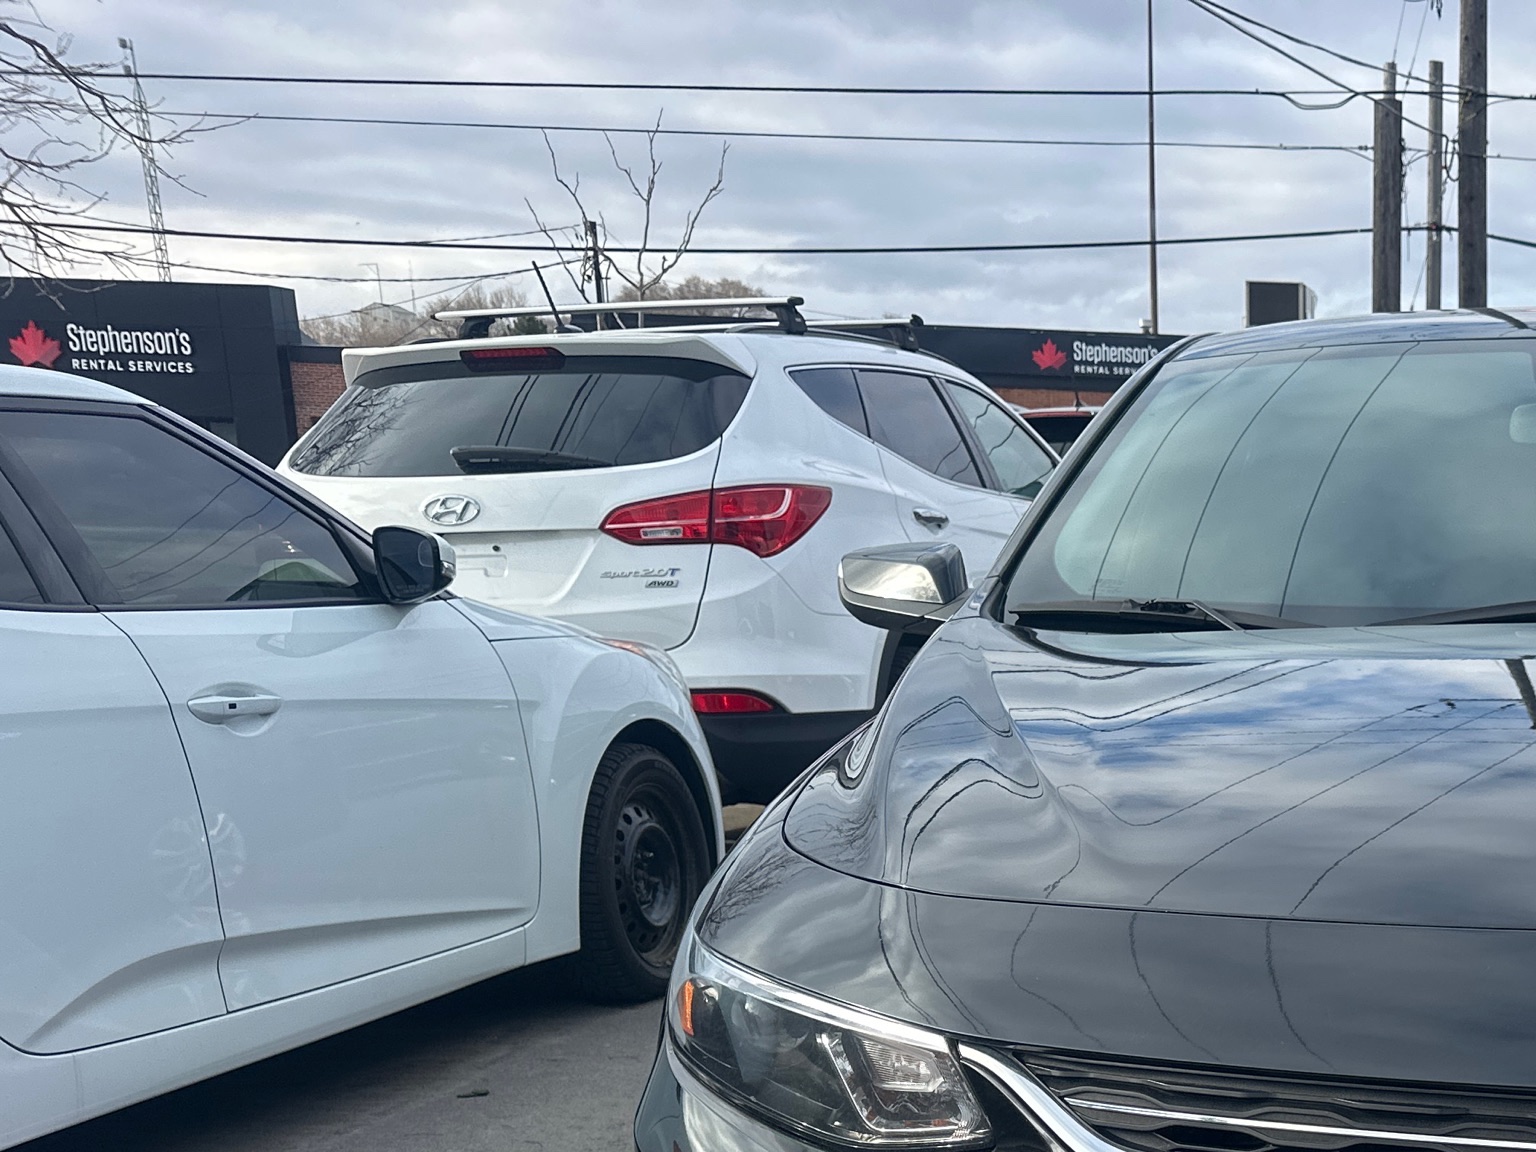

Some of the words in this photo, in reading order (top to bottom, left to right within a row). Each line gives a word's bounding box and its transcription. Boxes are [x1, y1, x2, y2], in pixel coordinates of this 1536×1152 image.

[66, 323, 192, 355] Stephenson's
[1073, 341, 1158, 364] Stephenson's
[71, 358, 124, 371] RENTAL
[128, 360, 194, 373] SERVICES
[1073, 365, 1110, 375] RENTAL
[1112, 367, 1138, 375] SERV
